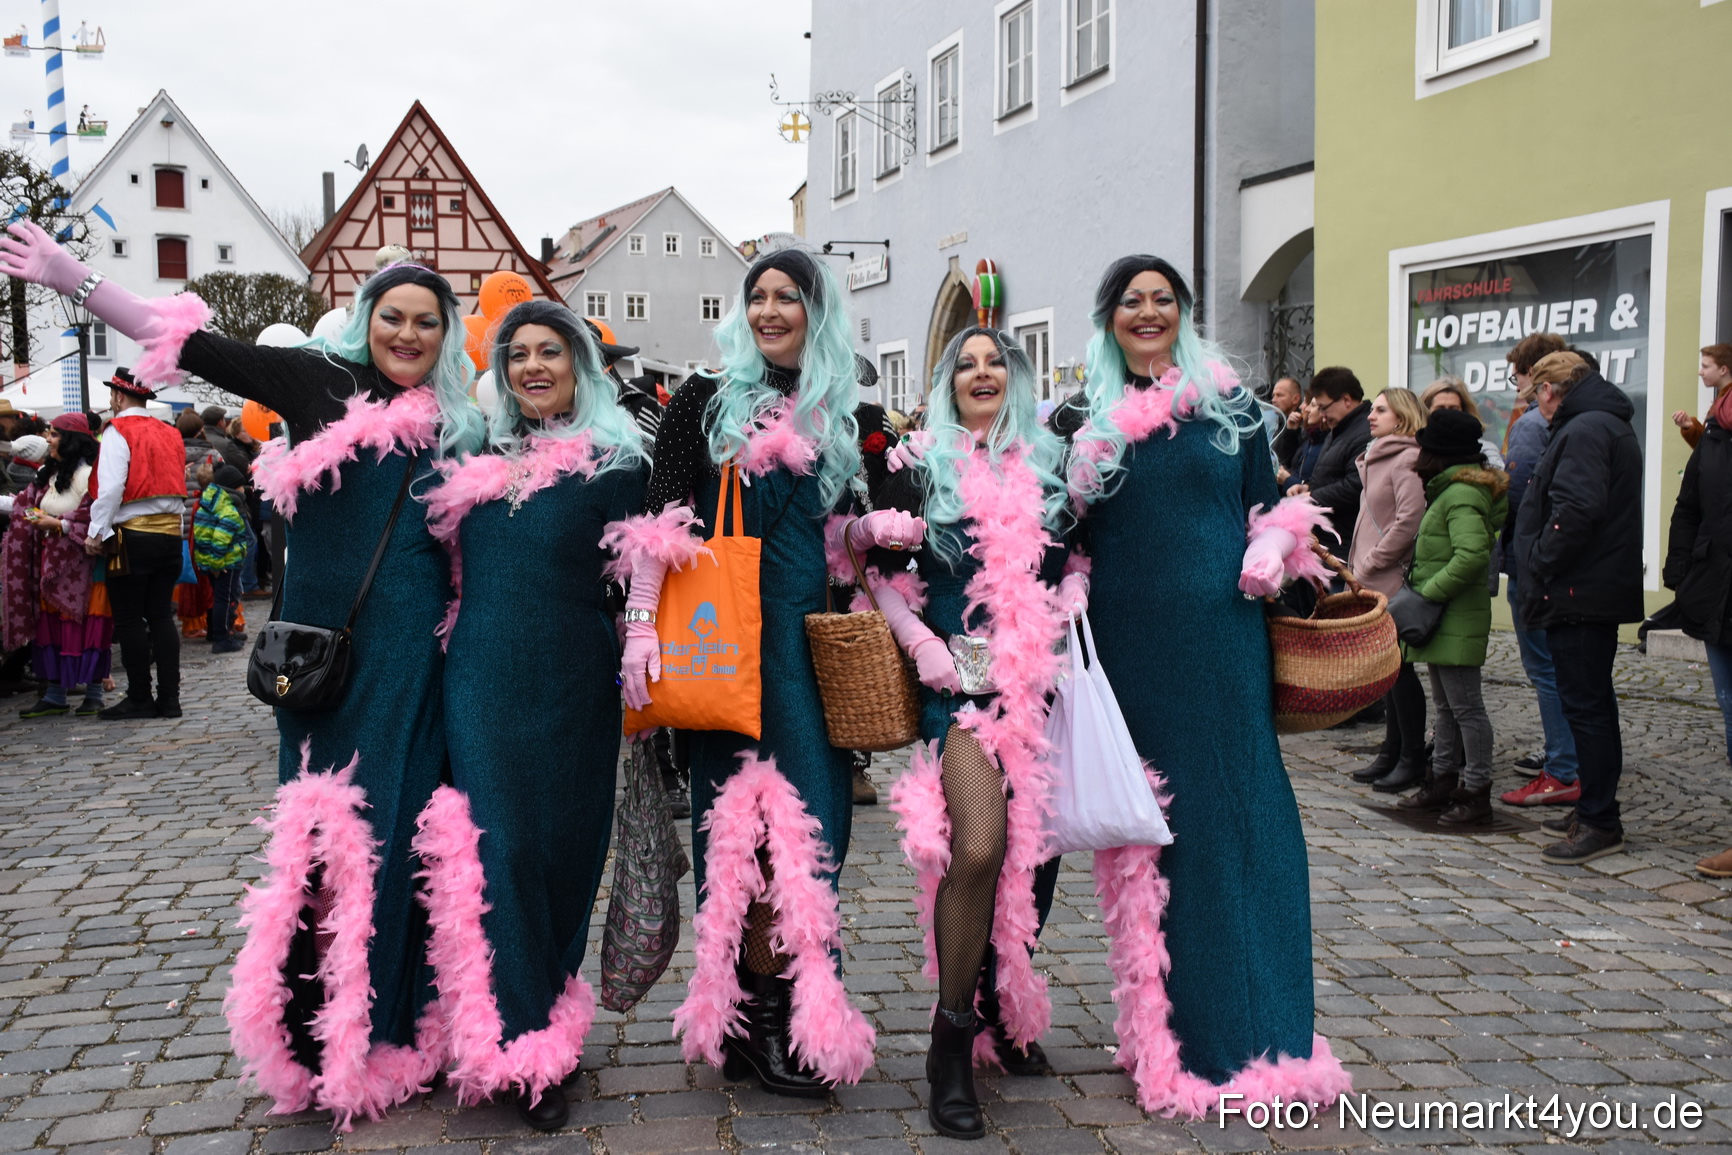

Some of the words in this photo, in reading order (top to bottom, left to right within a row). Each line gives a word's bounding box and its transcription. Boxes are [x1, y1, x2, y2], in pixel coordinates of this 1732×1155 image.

[1417, 277, 1513, 304] FAHRSCHULE
[1415, 298, 1598, 350] HOFBAUER
[1609, 293, 1639, 331] &
